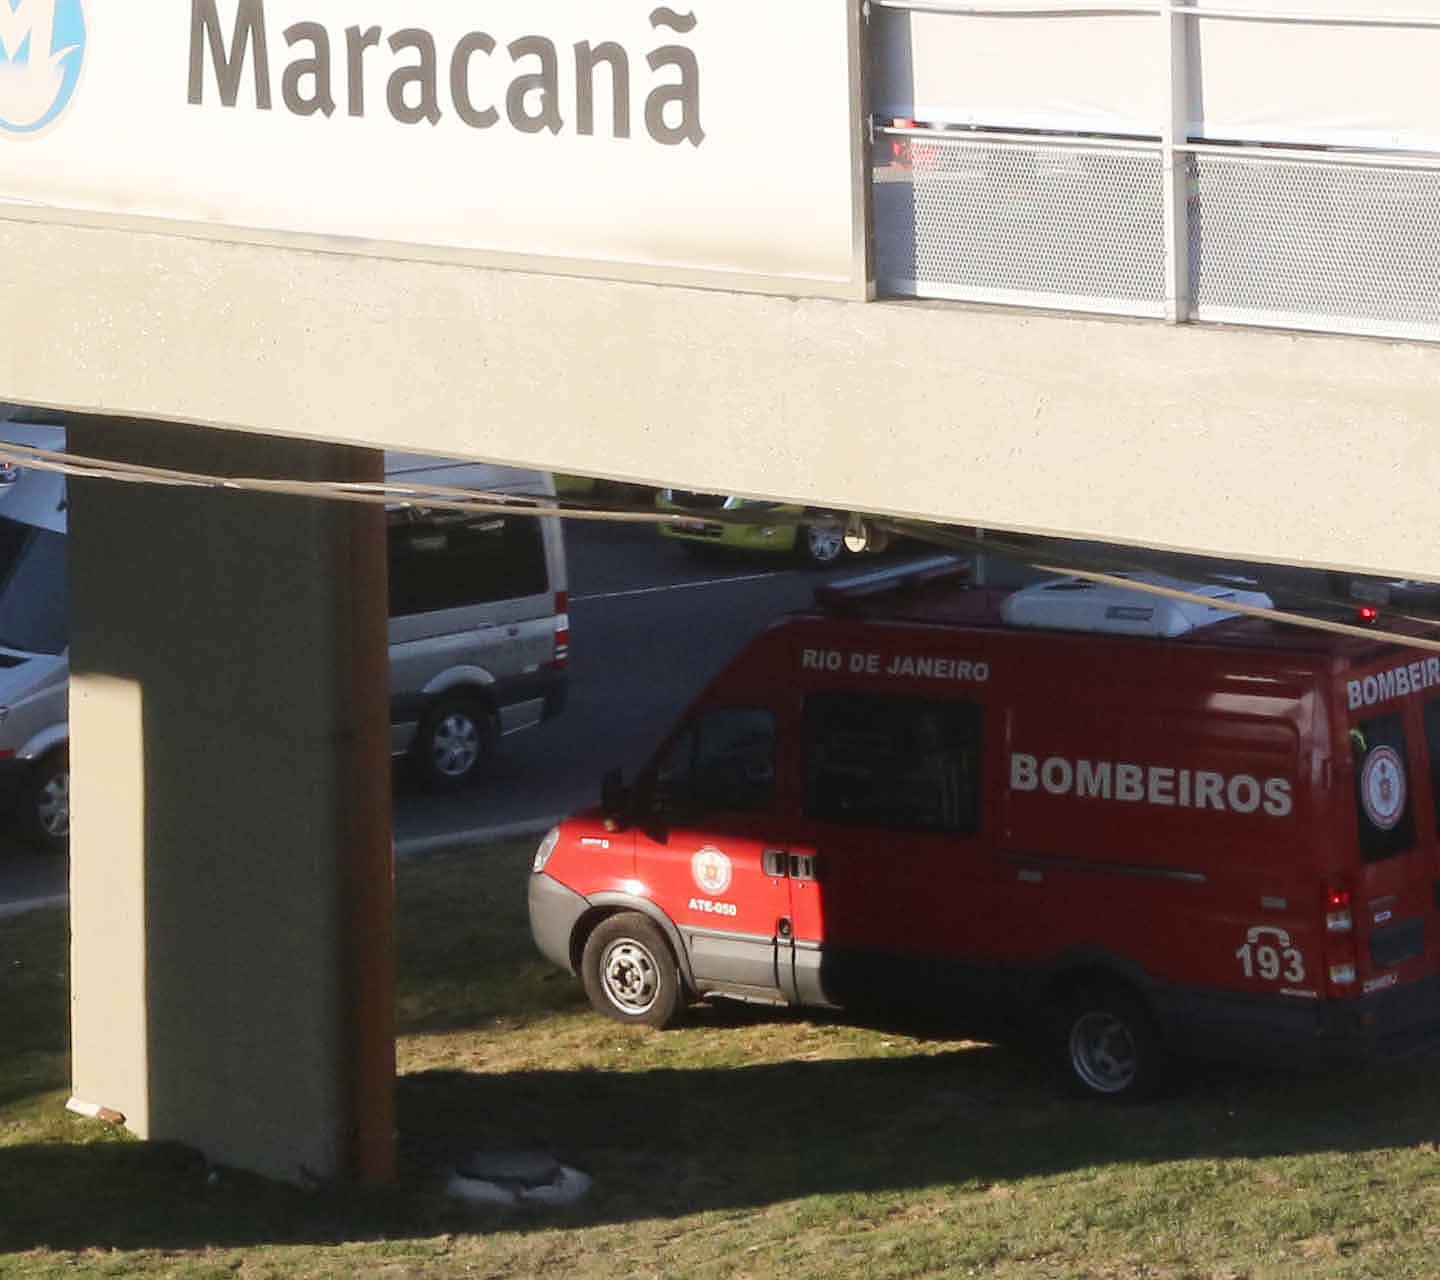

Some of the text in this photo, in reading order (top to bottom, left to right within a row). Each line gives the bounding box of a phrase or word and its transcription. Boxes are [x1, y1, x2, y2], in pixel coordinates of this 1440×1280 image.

[802, 648, 991, 683] RIO DE JANEIRO
[1009, 753, 1293, 817] BOMBEIROS
[1235, 944, 1305, 983] 193
